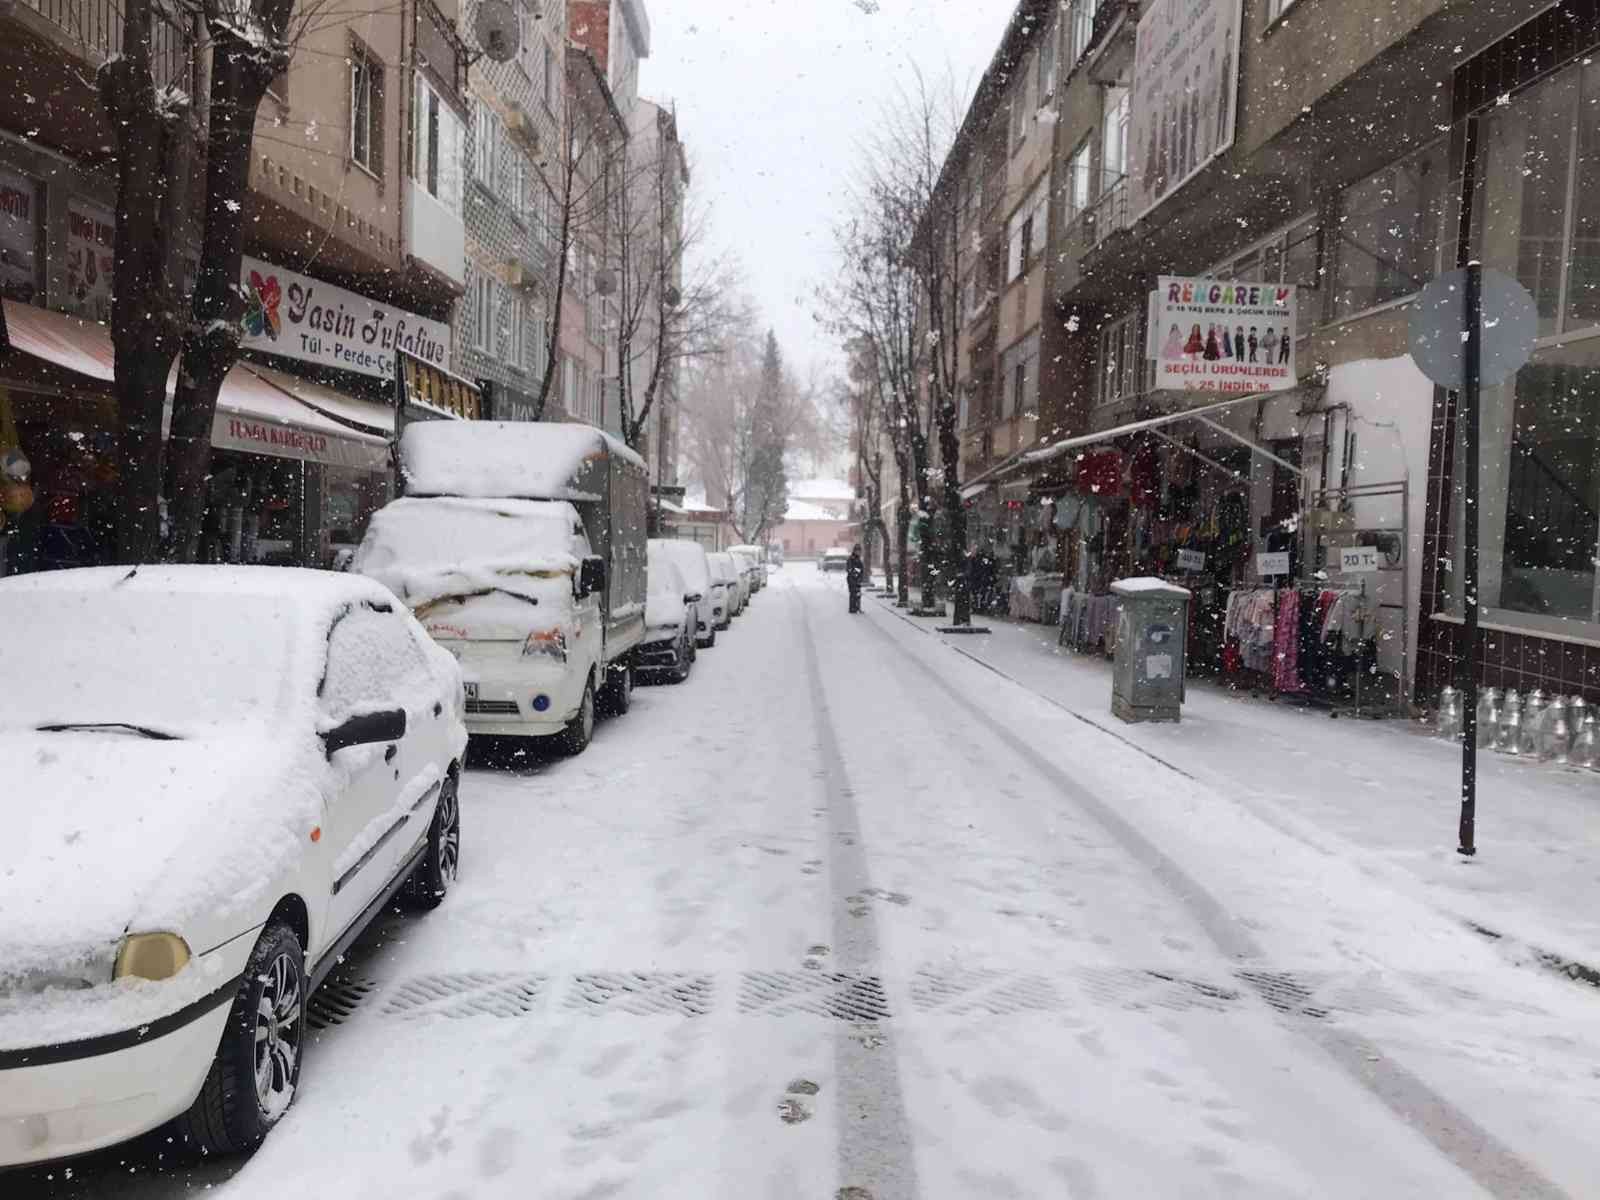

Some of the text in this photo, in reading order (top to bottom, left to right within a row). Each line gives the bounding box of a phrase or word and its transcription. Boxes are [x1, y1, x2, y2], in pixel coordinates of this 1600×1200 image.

[1168, 282, 1289, 306] RENGARENK
[288, 283, 355, 339] Yasin
[300, 334, 322, 354] Tül
[335, 343, 396, 374] Perde-Çe
[1165, 362, 1289, 377] SEÇİLİ ÜRÜNLERDE
[1199, 380, 1215, 391] 25
